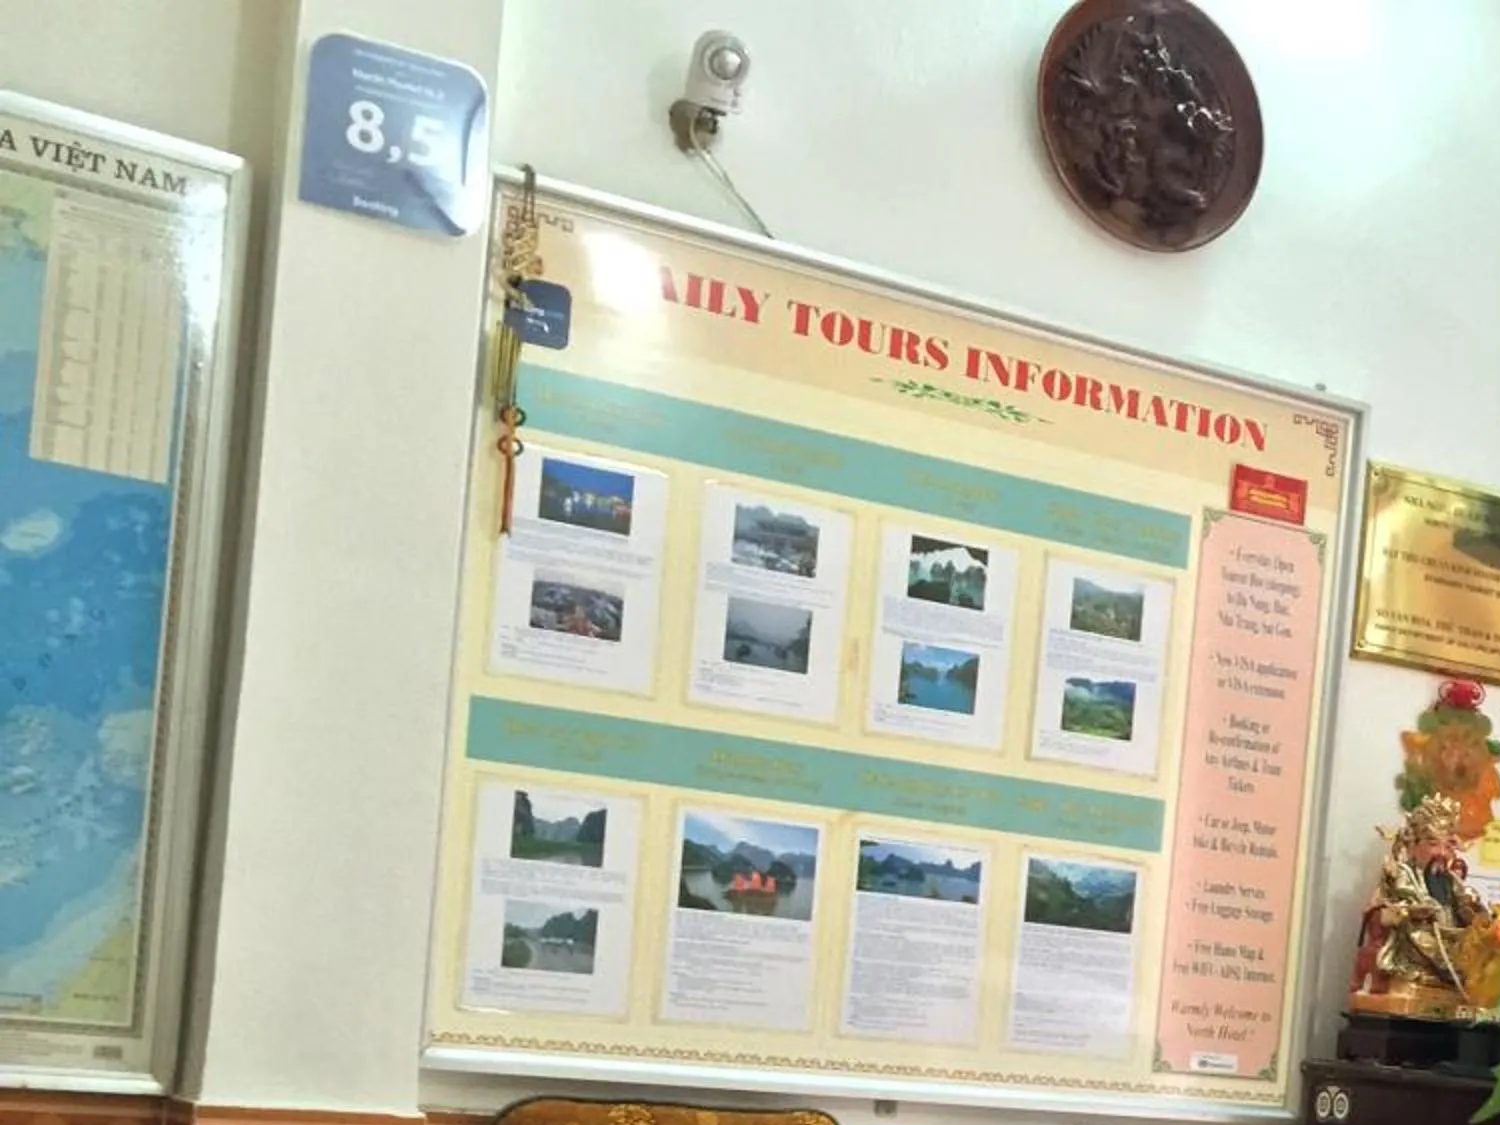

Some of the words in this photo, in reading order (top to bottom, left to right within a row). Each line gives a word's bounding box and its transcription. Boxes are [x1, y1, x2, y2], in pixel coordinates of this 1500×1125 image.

[29, 136, 106, 173] VIỆT
[114, 158, 189, 197] NAM
[346, 100, 447, 167] 8,5
[660, 265, 771, 324] AILY
[787, 299, 950, 371] TOURS
[964, 346, 1269, 452] INFORMATION
